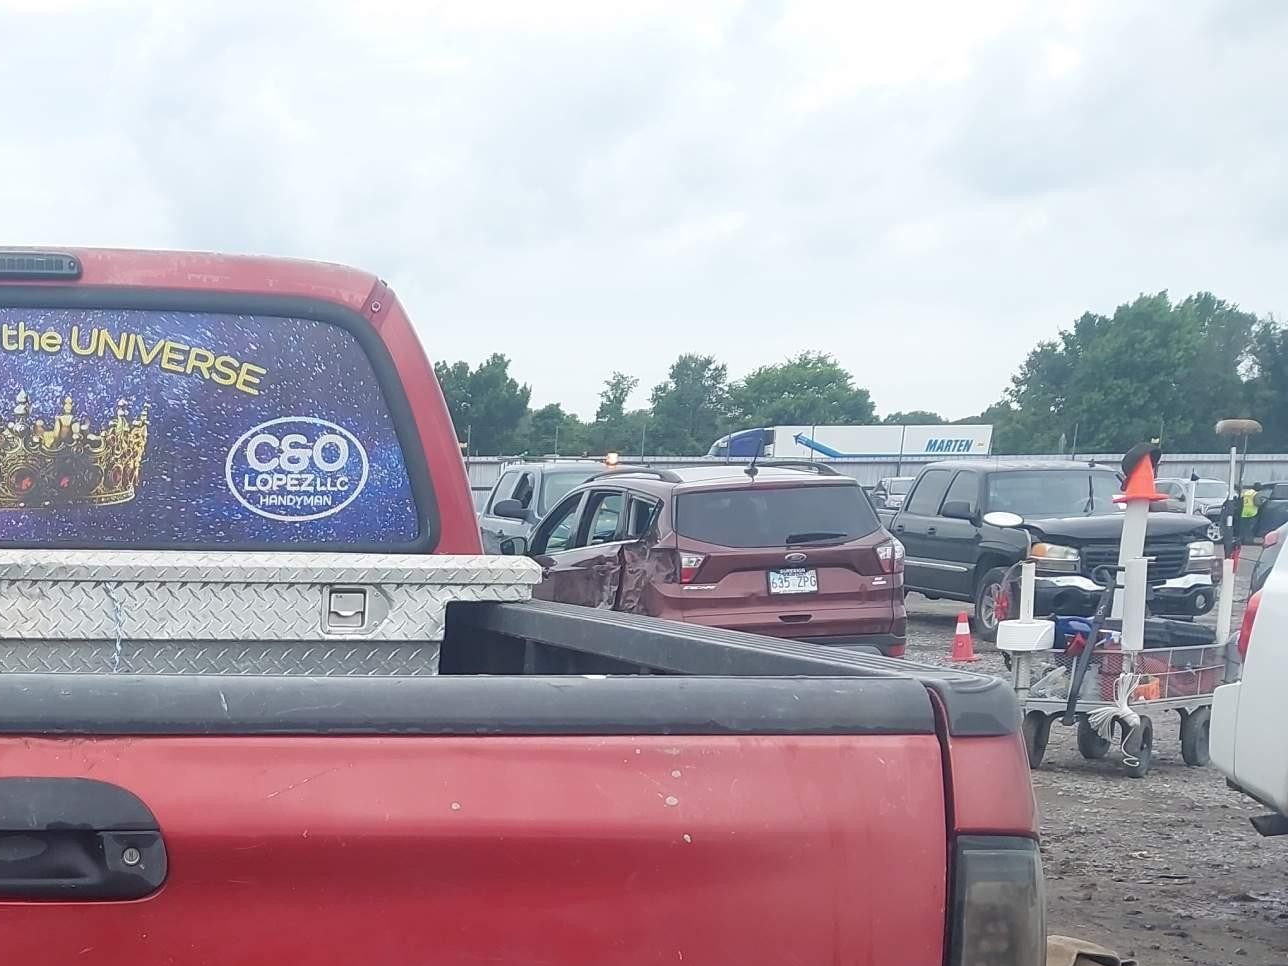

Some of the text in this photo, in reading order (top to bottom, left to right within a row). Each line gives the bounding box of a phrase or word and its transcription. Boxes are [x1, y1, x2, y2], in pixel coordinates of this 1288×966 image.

[2, 321, 63, 352] the
[71, 326, 266, 396] UNIVERSE
[247, 434, 348, 471] C&O
[925, 439, 973, 453] MARTEN
[244, 474, 349, 491] LOPEZ LLC
[260, 495, 332, 507] HANDYMAN
